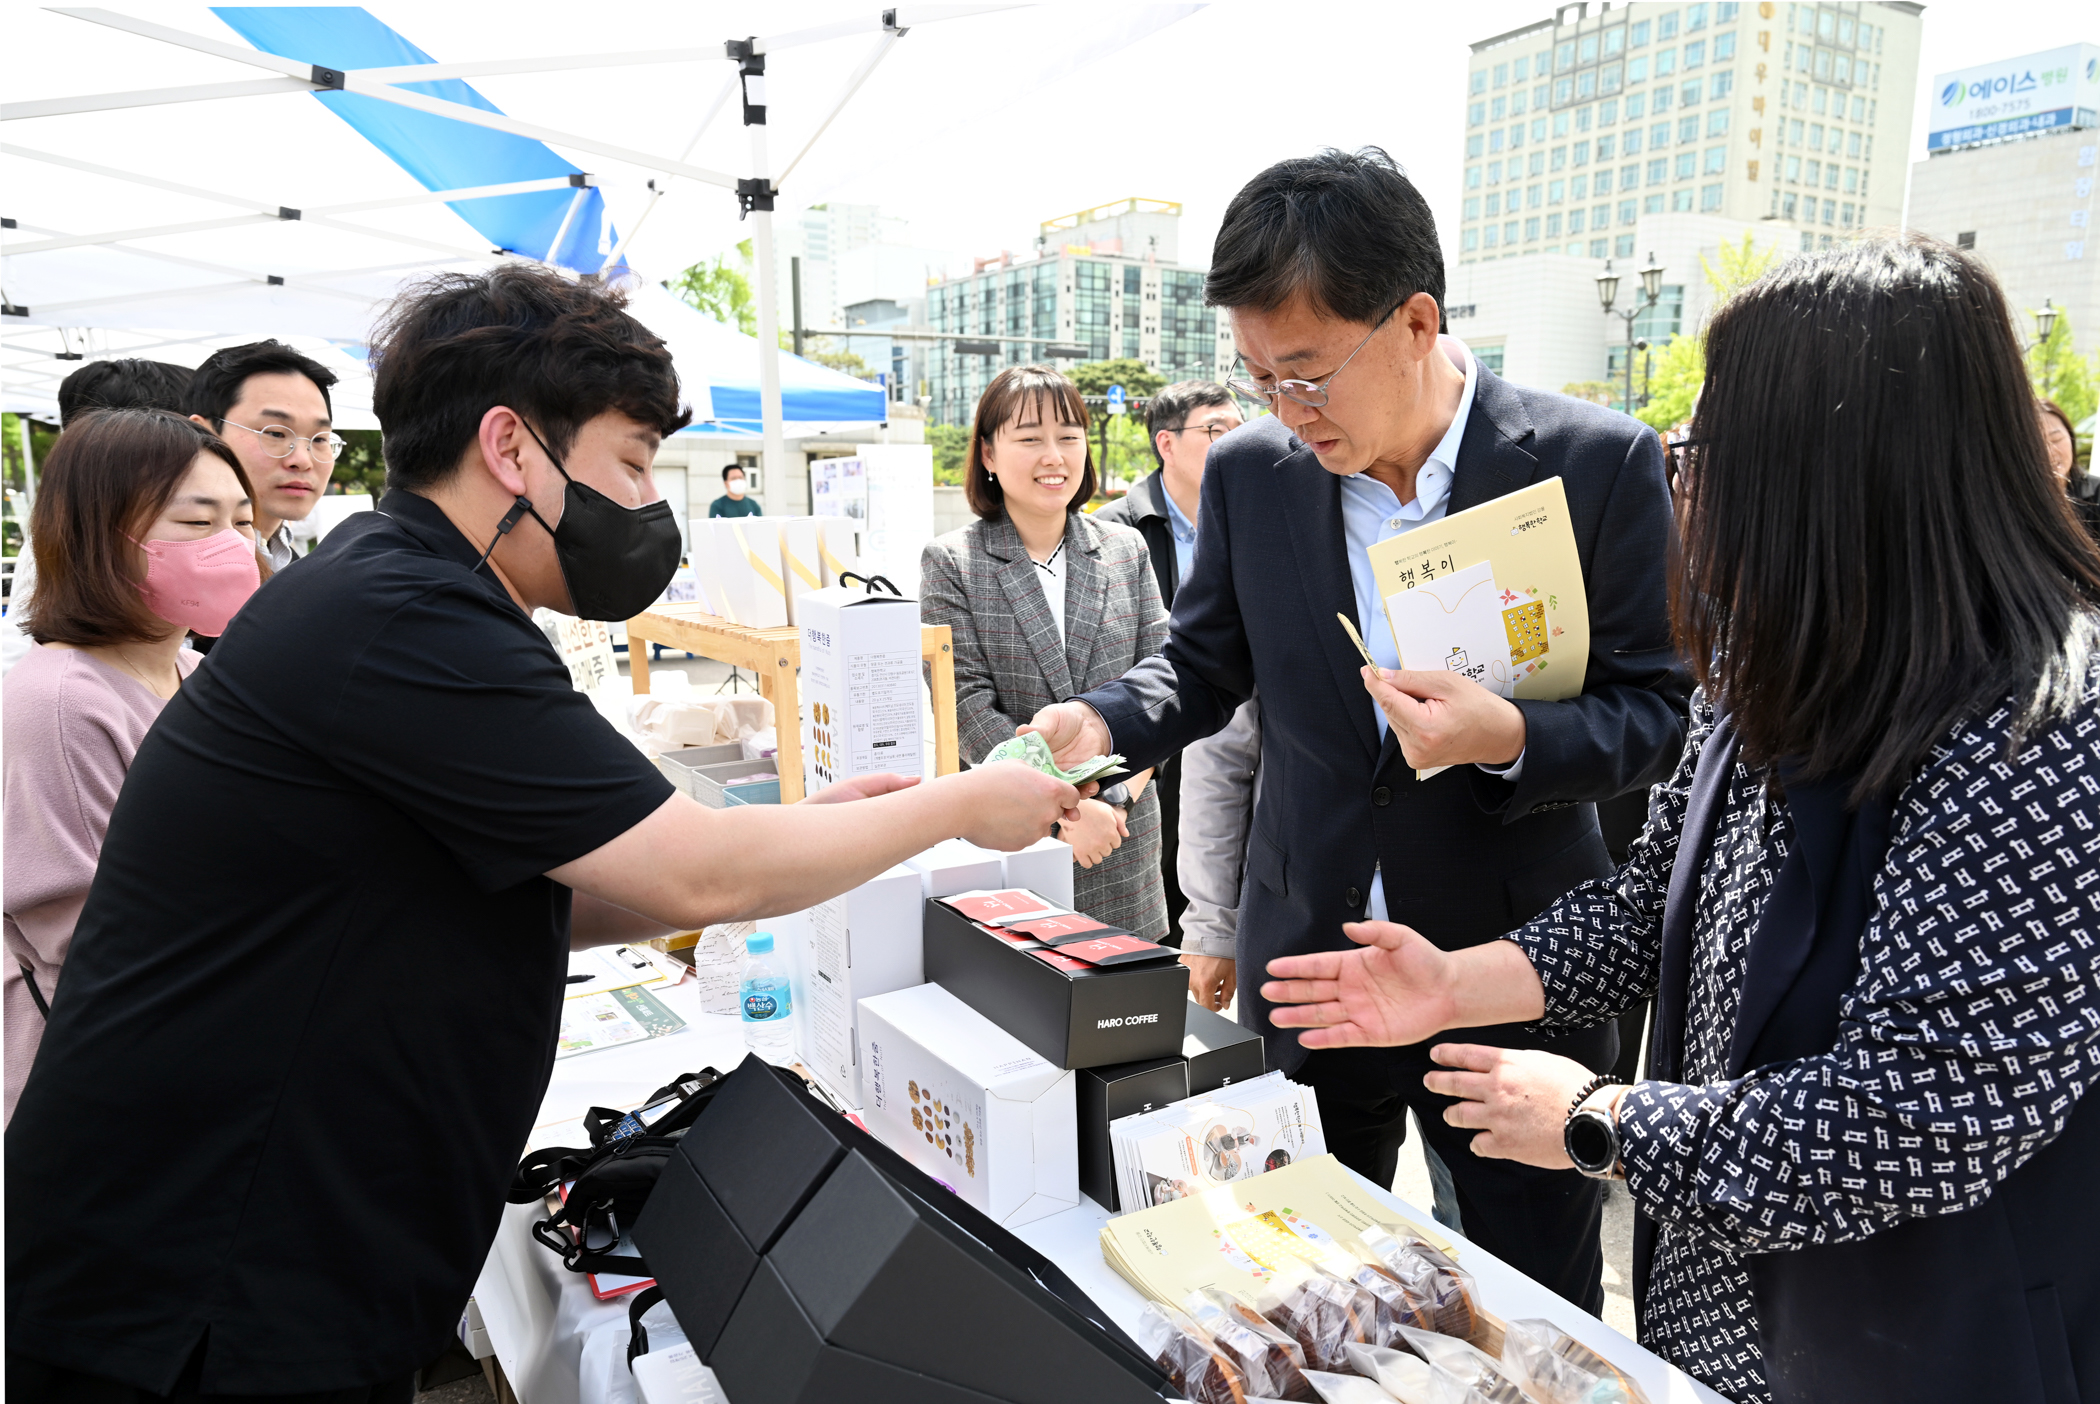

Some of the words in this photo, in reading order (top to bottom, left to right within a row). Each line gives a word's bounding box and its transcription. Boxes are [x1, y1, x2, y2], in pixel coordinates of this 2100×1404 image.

[1968, 70, 2038, 99] 에이스
[2041, 66, 2069, 87] 병원
[1747, 30, 1772, 183] 대우마이빌
[1968, 97, 2032, 120] 1800-7575
[1518, 515, 1548, 532] 행복한학교
[1399, 554, 1455, 590] 행복이
[180, 599, 200, 608] KF94
[1461, 664, 1485, 679] 학교
[831, 708, 841, 781] HAPPI
[747, 1001, 773, 1012] 백산수
[1097, 1017, 1123, 1029] HARO
[1125, 1013, 1159, 1026] COFFEE
[871, 1041, 883, 1108] 더행복한줌
